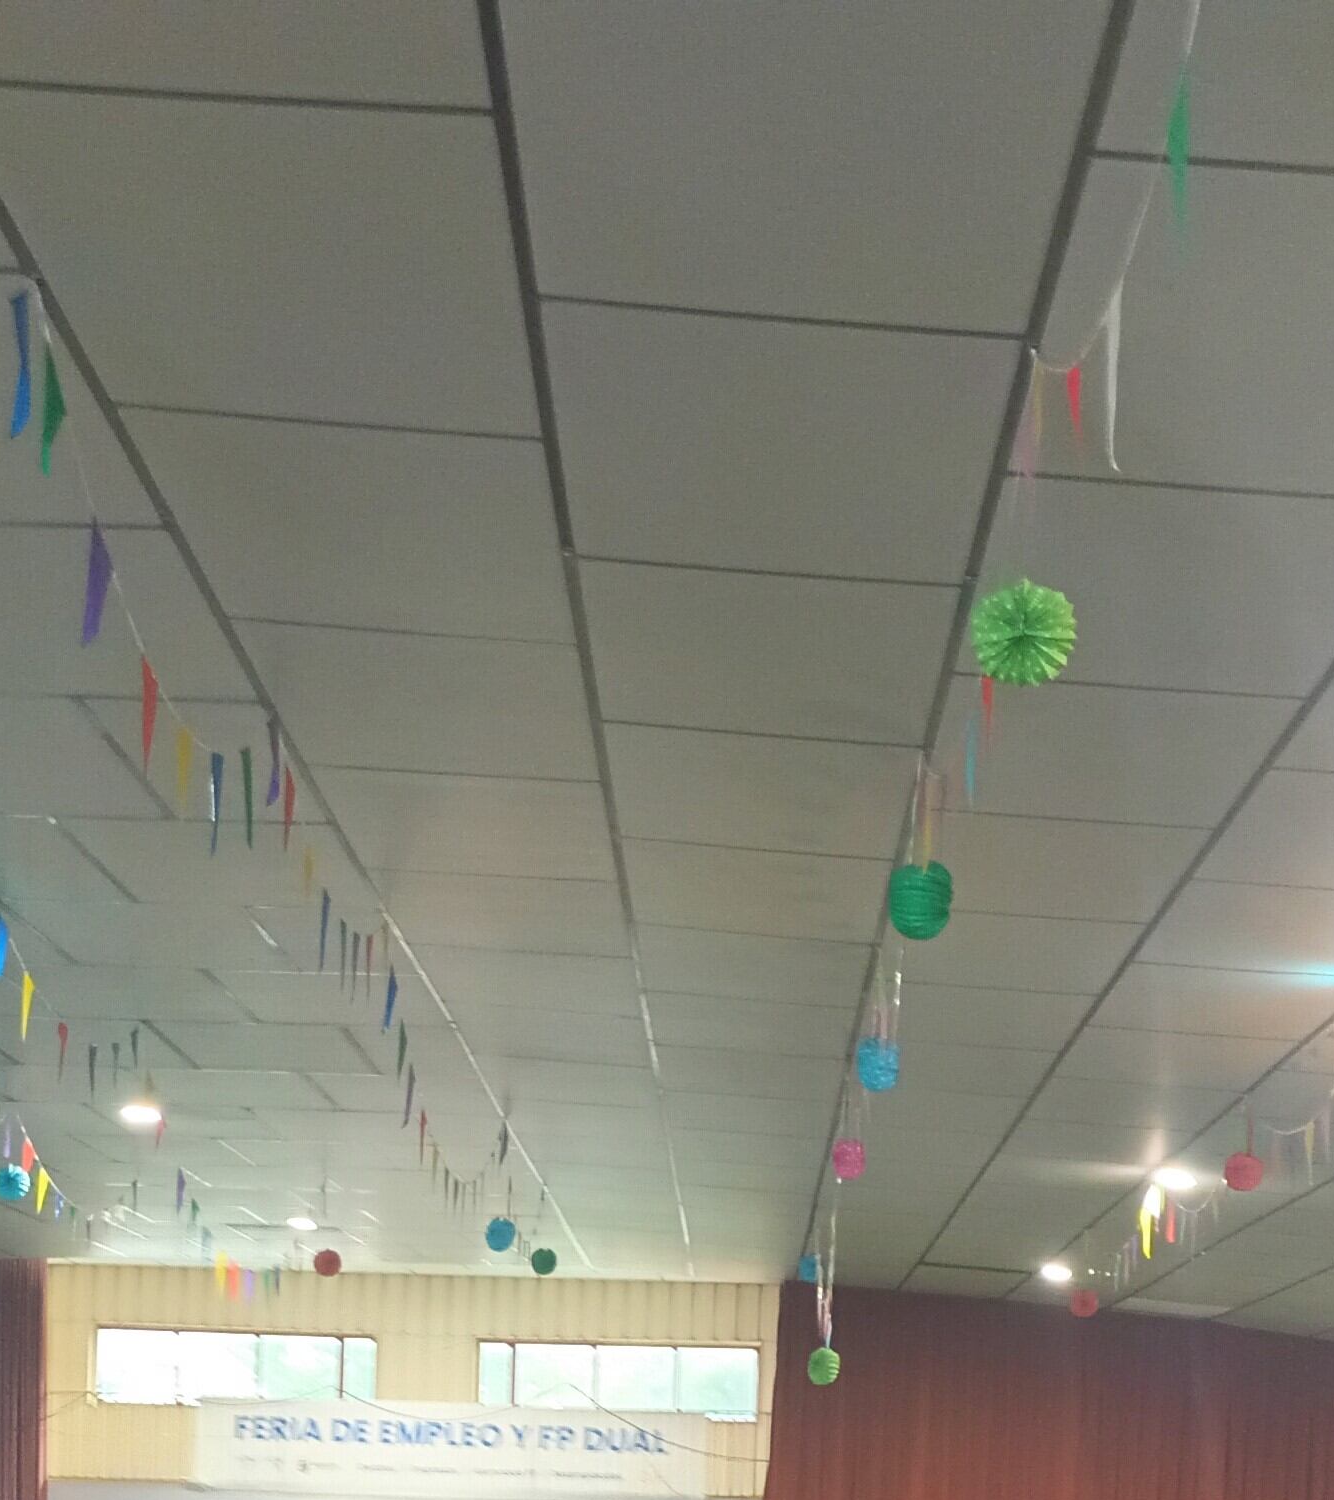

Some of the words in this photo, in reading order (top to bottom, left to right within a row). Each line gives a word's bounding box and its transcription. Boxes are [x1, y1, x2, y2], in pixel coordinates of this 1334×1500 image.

[233, 1414, 321, 1443] FERIA
[331, 1418, 369, 1444] DE
[378, 1419, 502, 1449] EMPLEO
[510, 1424, 531, 1449] Y
[537, 1426, 578, 1452] FP
[583, 1427, 668, 1454] DUAL
